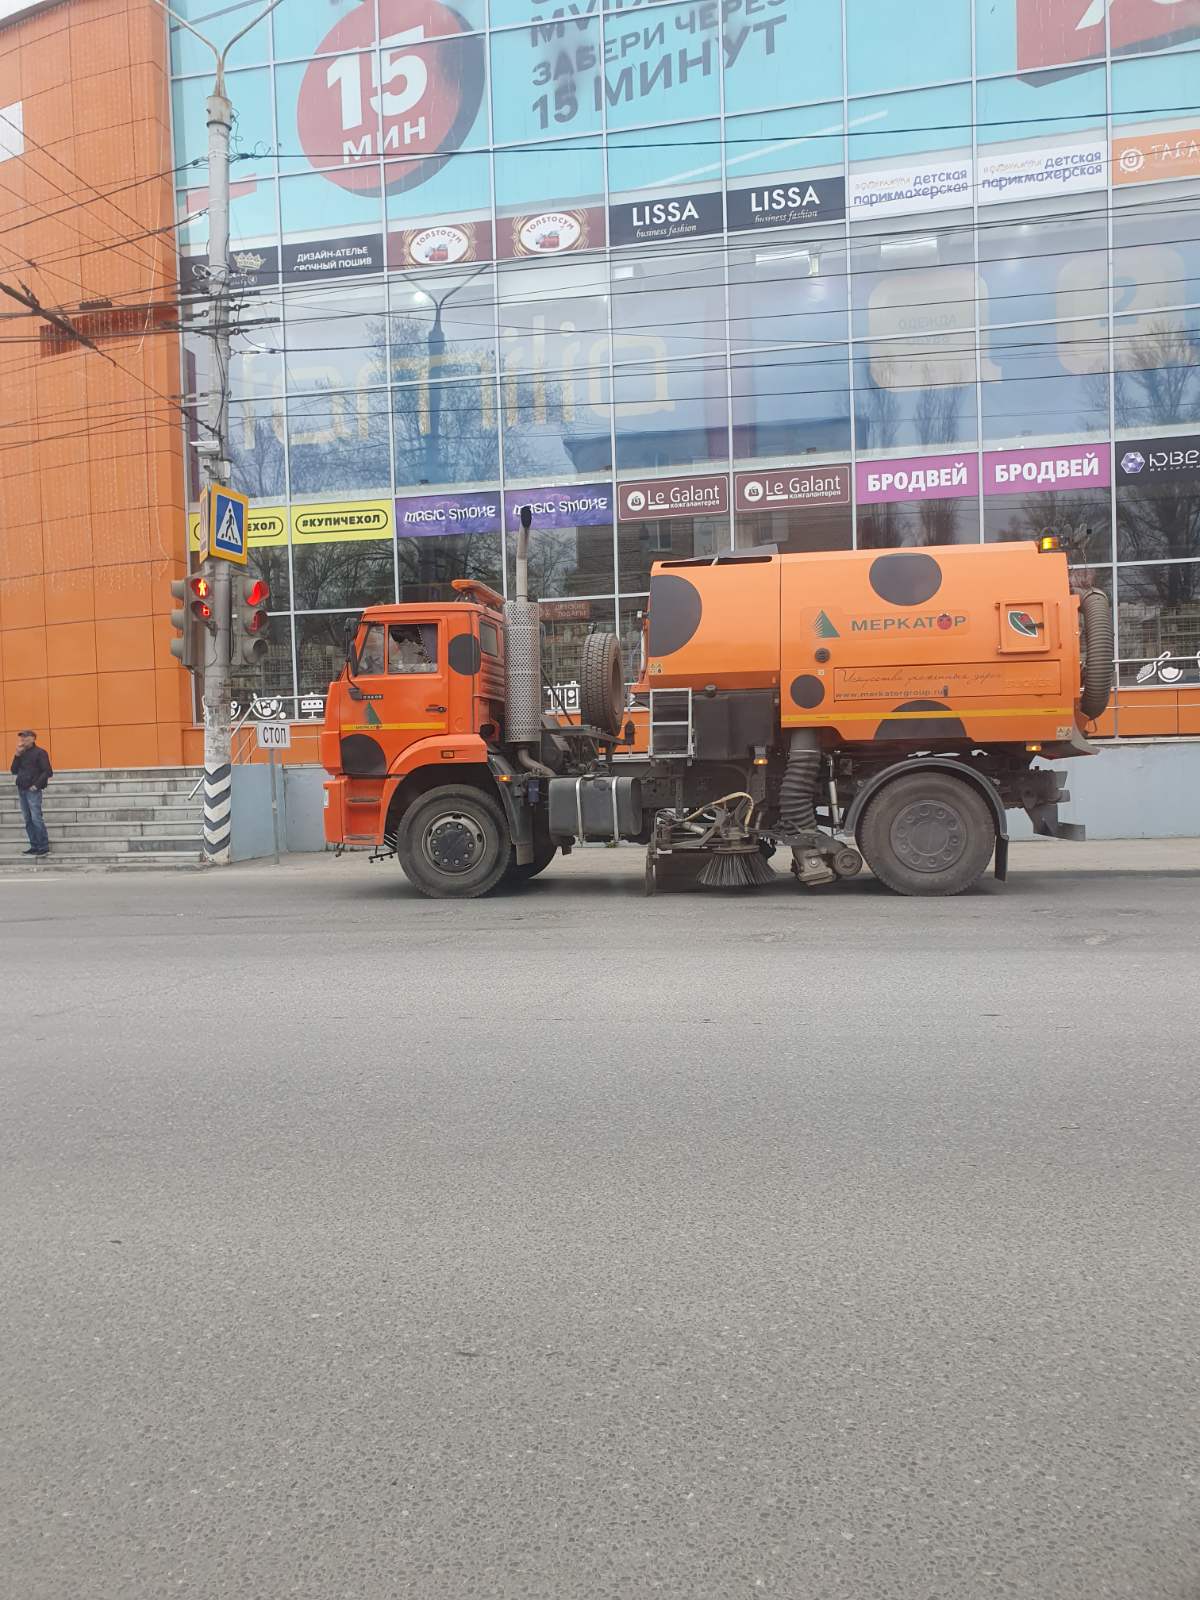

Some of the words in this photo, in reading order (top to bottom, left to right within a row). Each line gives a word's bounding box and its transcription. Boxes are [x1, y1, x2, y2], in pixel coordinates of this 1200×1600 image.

[532, 22, 665, 86] ЗАБЕРИ
[326, 24, 428, 131] 15
[532, 79, 578, 130] 15
[594, 14, 787, 112] МИНУТ
[342, 116, 426, 165] МИН
[1044, 151, 1102, 170] детская
[913, 169, 968, 188] детская
[981, 164, 1103, 191] парикмахерская
[751, 185, 820, 212] LISSA
[853, 182, 968, 207] парикмахерская
[632, 200, 699, 227] LISSA
[754, 213, 786, 224] business
[636, 228, 667, 239] business
[665, 224, 697, 238] fashion
[297, 246, 368, 263] ДИЗАЙН-АТЕЛЬЕ
[338, 257, 372, 269] ПОШИВ
[867, 462, 968, 493] БРОДВЕЙ
[995, 452, 1099, 484] БРОДВЕЙ
[647, 490, 665, 504] Le
[670, 485, 720, 504] Galant
[765, 480, 784, 495] Le
[788, 475, 841, 494] Galant
[302, 514, 381, 528] #КУПИЧЕХОЛ
[263, 726, 287, 744] СТОП
